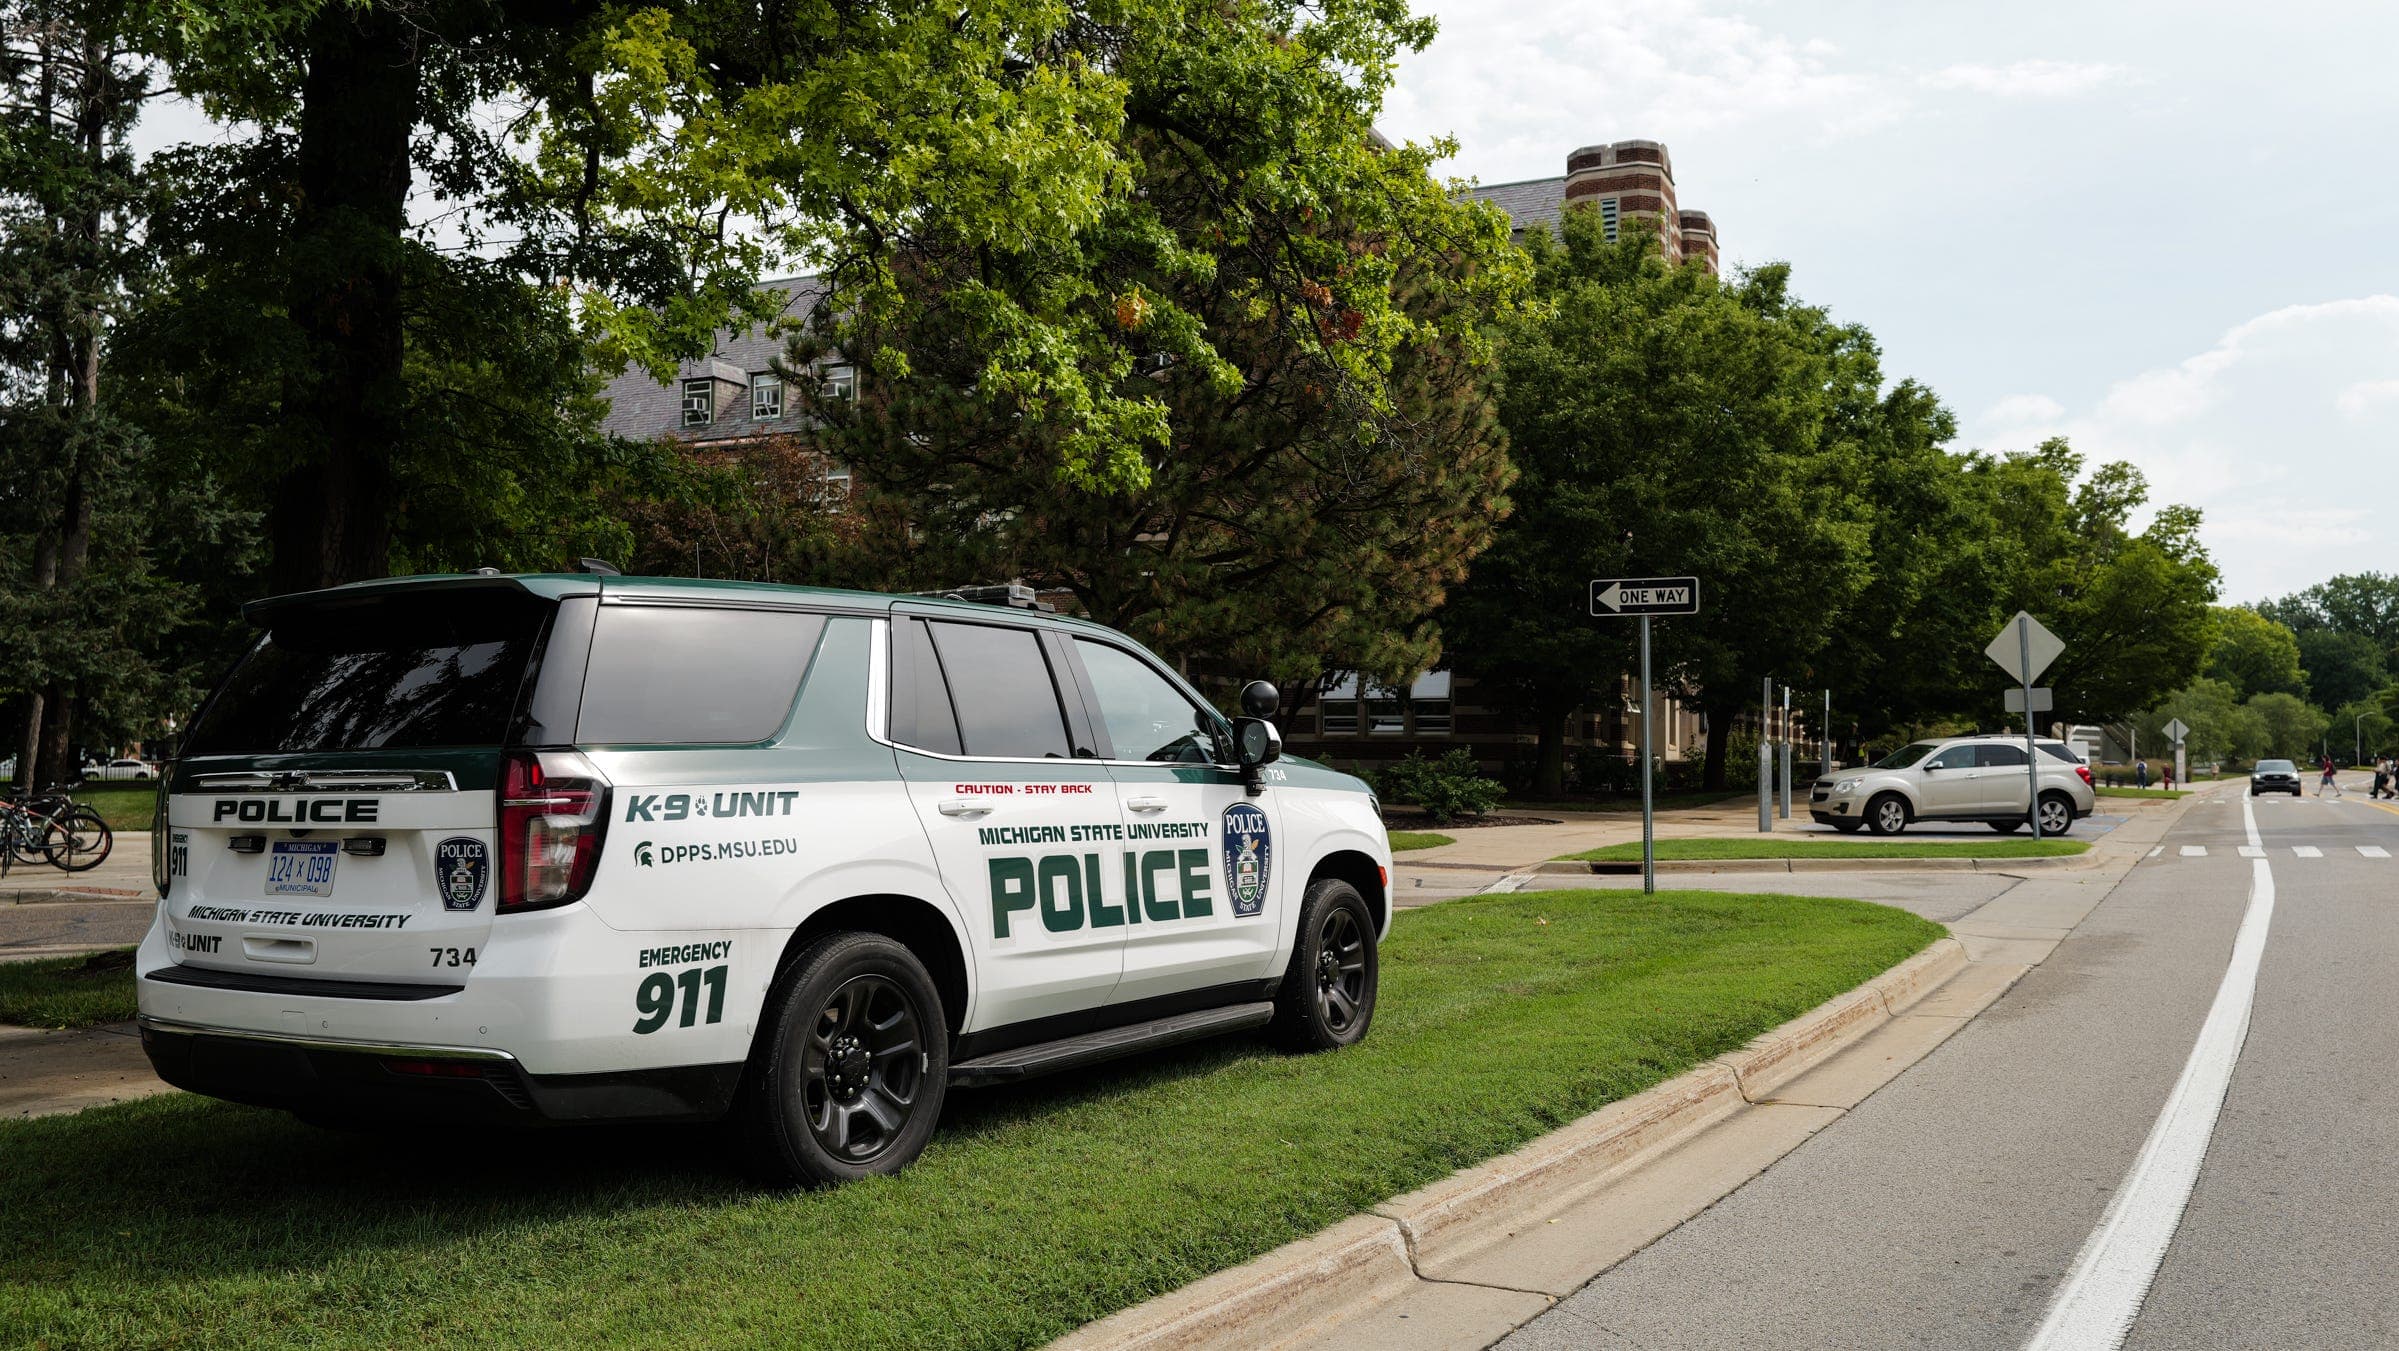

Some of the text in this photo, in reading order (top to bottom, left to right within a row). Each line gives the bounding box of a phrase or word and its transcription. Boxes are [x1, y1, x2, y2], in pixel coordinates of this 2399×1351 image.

[1620, 589, 1685, 603] ONE WAY
[1268, 769, 1287, 781] 734
[955, 784, 1013, 794] CAUTION
[1025, 784, 1057, 794] STAY
[1061, 784, 1092, 794] BACK
[213, 799, 379, 822] POLICE
[625, 791, 800, 822] K-9 UNIT
[978, 822, 1209, 845] MICHIGAN STATE UNIVERSITY
[1225, 813, 1265, 834] POLICE
[288, 843, 322, 852] MICHIGAN
[441, 844, 482, 858] POLICE
[661, 838, 797, 864] DPPS.MSU.EDU
[172, 846, 188, 876] 911
[269, 855, 294, 882] 124
[306, 856, 332, 883] 098
[279, 884, 316, 893] MUNICIPAL
[988, 848, 1214, 939] POLICE
[188, 904, 412, 929] MICHIGAN STATE UNIVERSITY
[187, 933, 222, 954] UNIT
[639, 940, 732, 968] EMERGENCY
[430, 947, 477, 967] 734
[632, 965, 728, 1035] 911
